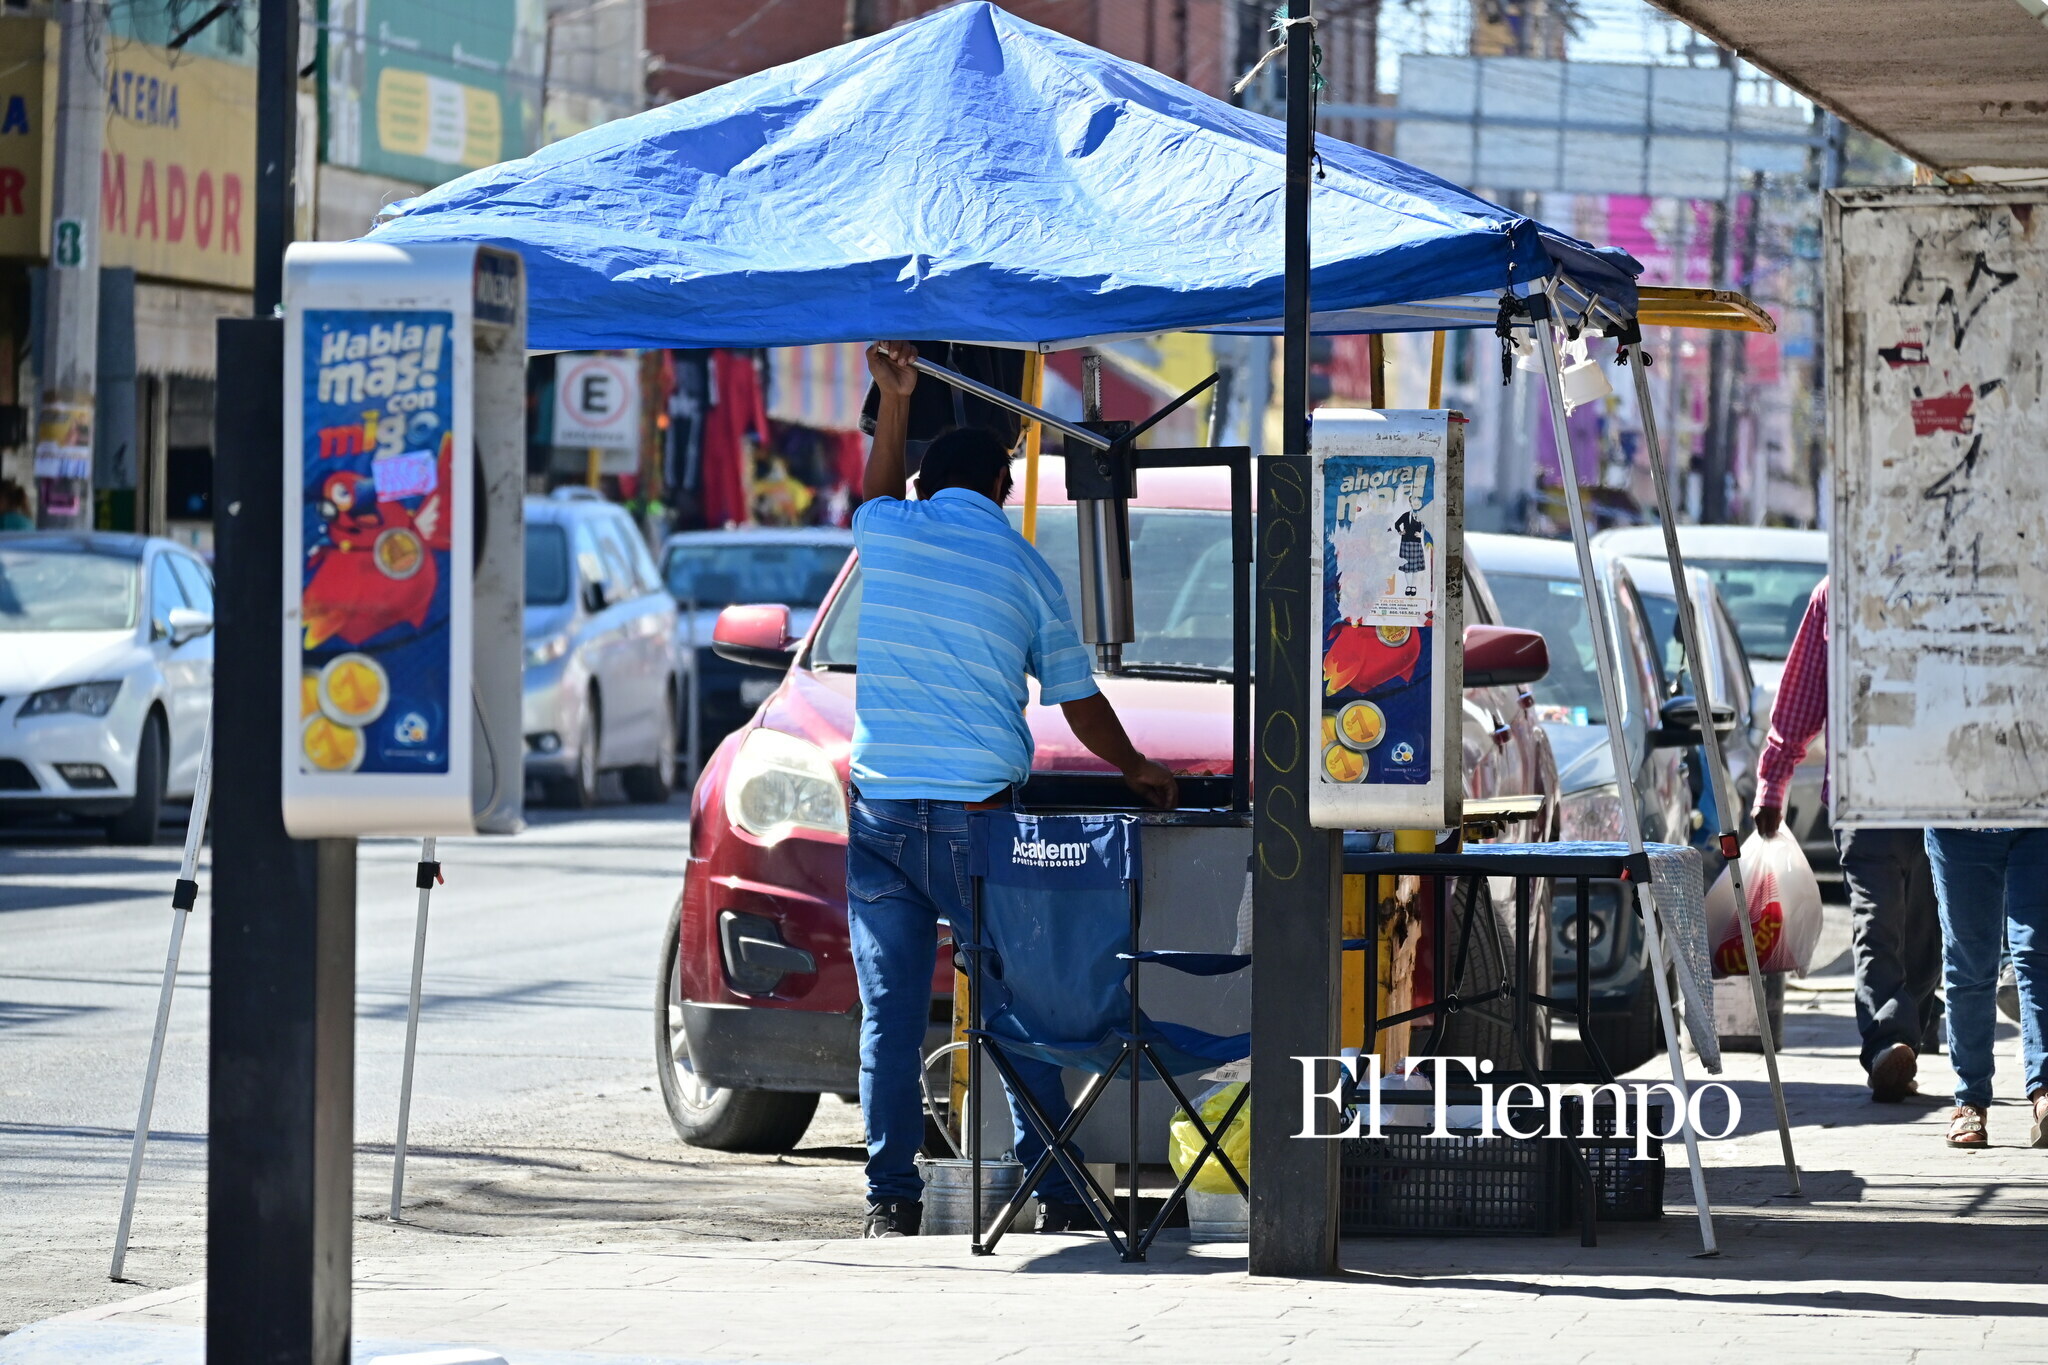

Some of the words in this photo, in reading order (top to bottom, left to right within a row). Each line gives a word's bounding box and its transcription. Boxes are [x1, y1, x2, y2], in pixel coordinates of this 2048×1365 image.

[386, 390, 437, 414] con
[582, 375, 609, 413] E
[1340, 465, 1413, 493] ahorra
[1013, 837, 1087, 864] Academy
